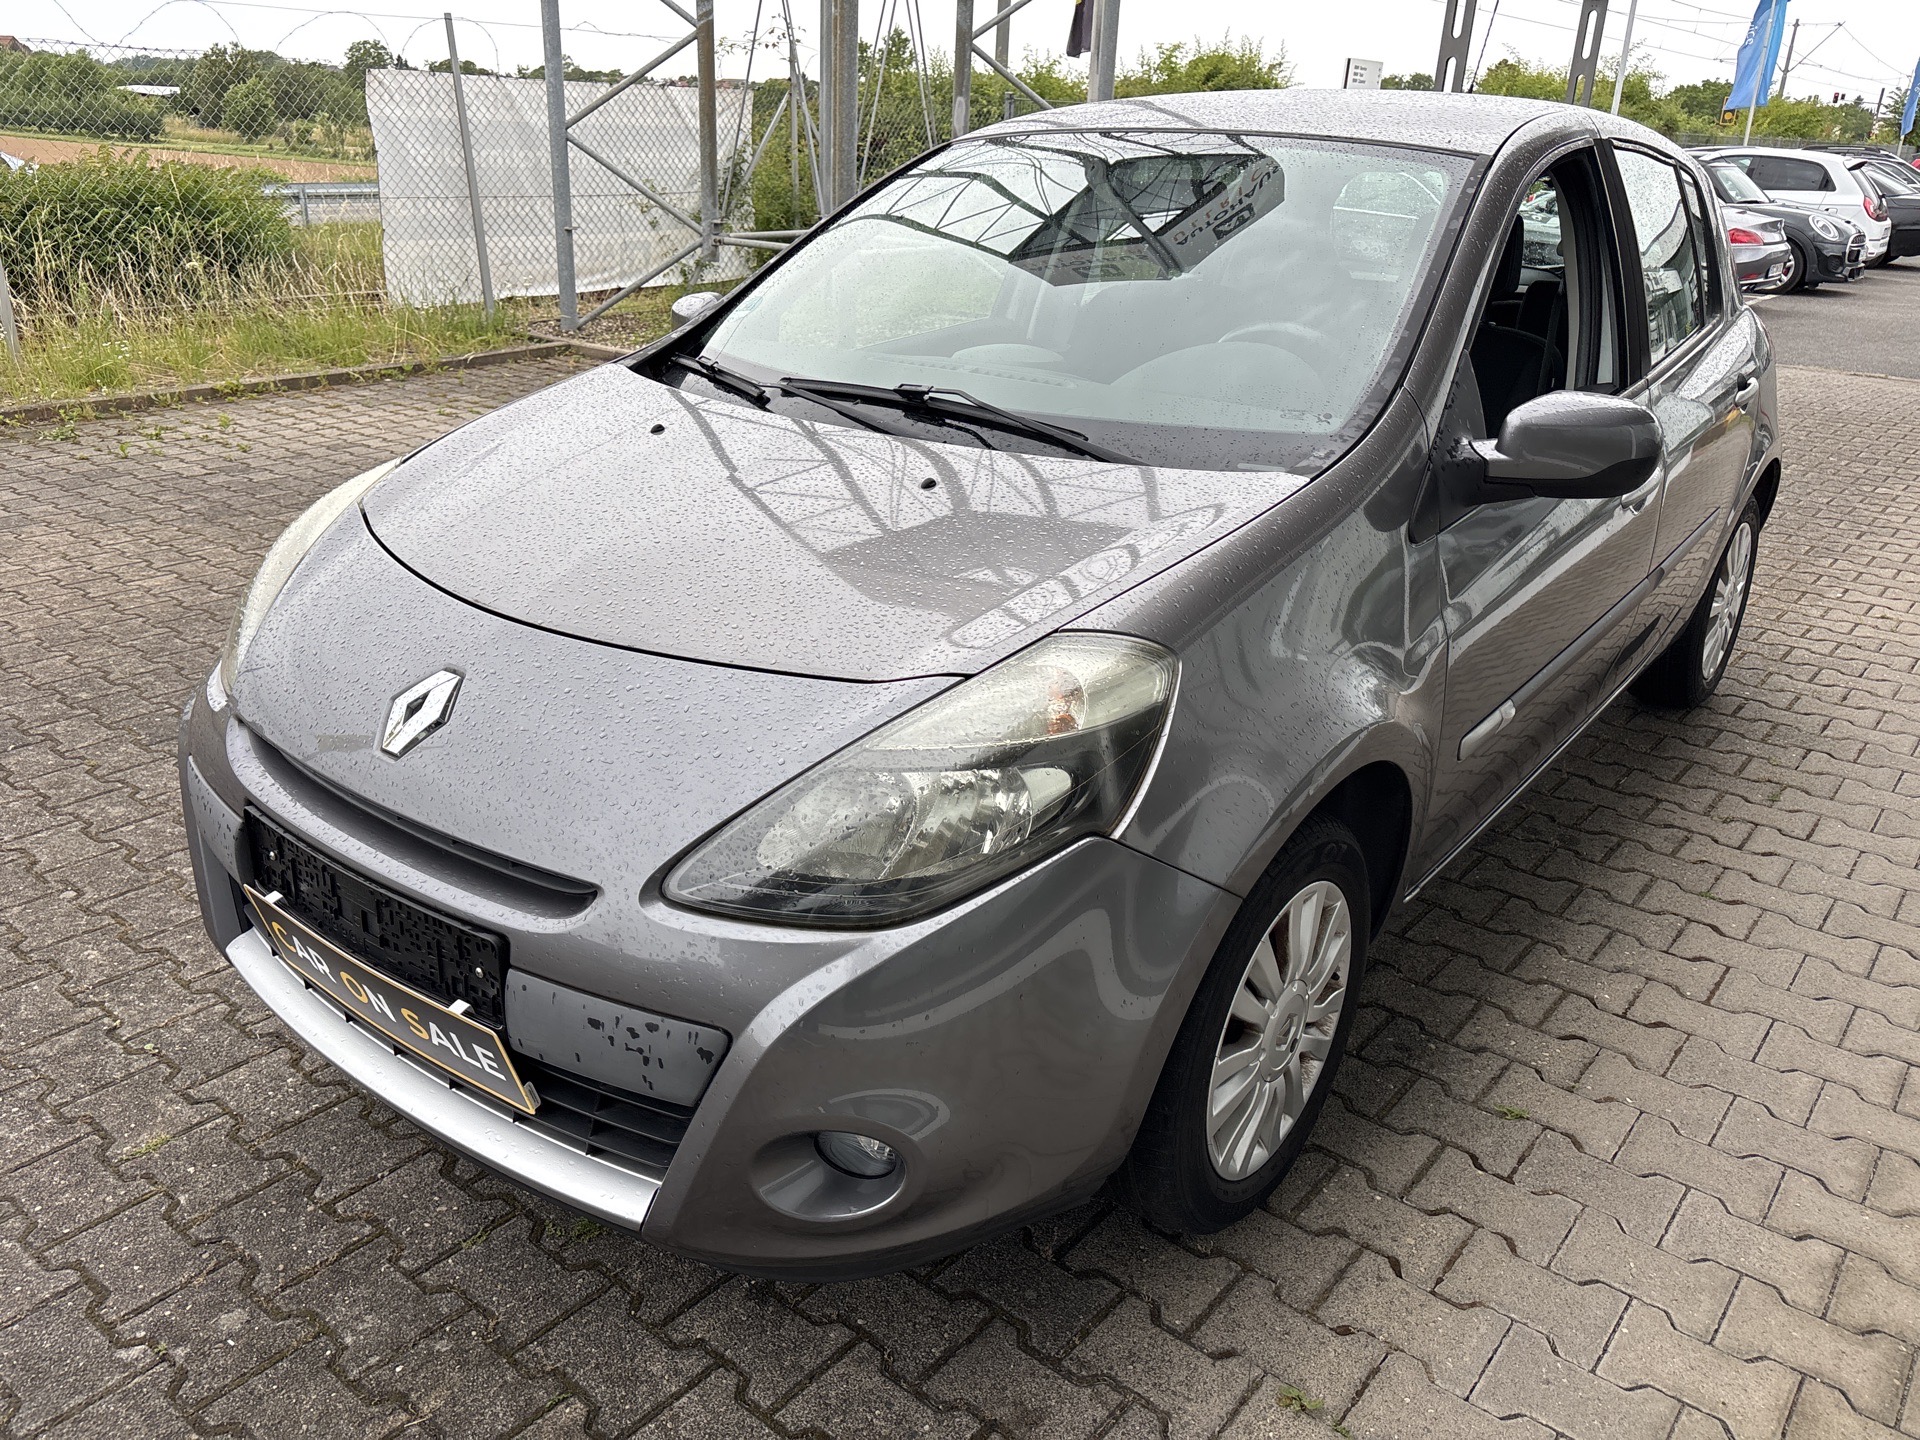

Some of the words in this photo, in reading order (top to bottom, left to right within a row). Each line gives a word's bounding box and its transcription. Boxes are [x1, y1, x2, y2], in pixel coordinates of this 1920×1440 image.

[271, 921, 337, 984] CAR
[340, 971, 397, 1022] ON
[401, 1007, 507, 1082] SALE
